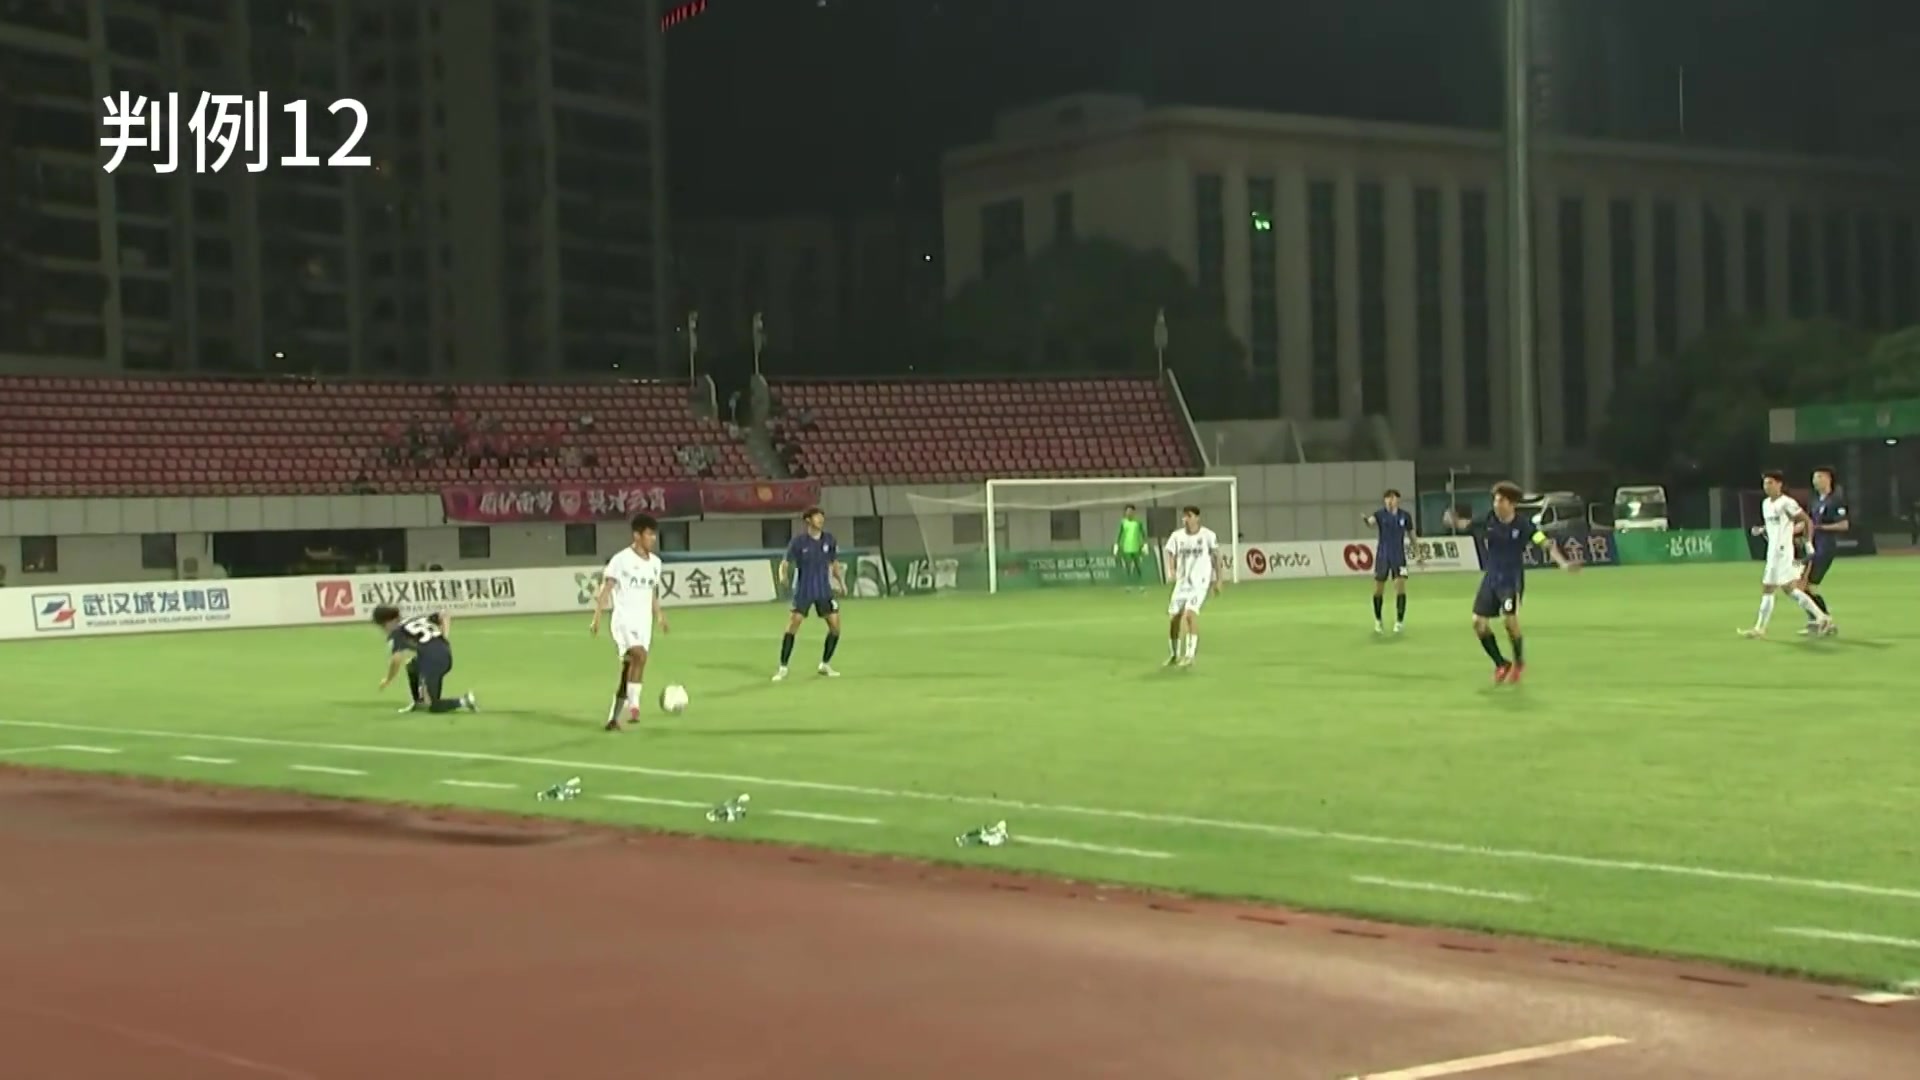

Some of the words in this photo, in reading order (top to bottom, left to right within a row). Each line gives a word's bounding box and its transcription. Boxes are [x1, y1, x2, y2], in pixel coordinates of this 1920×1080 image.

[82, 588, 230, 616] 武汉城发集团
[359, 576, 516, 604] 武汉城建集团
[1504, 599, 1514, 612] 6
